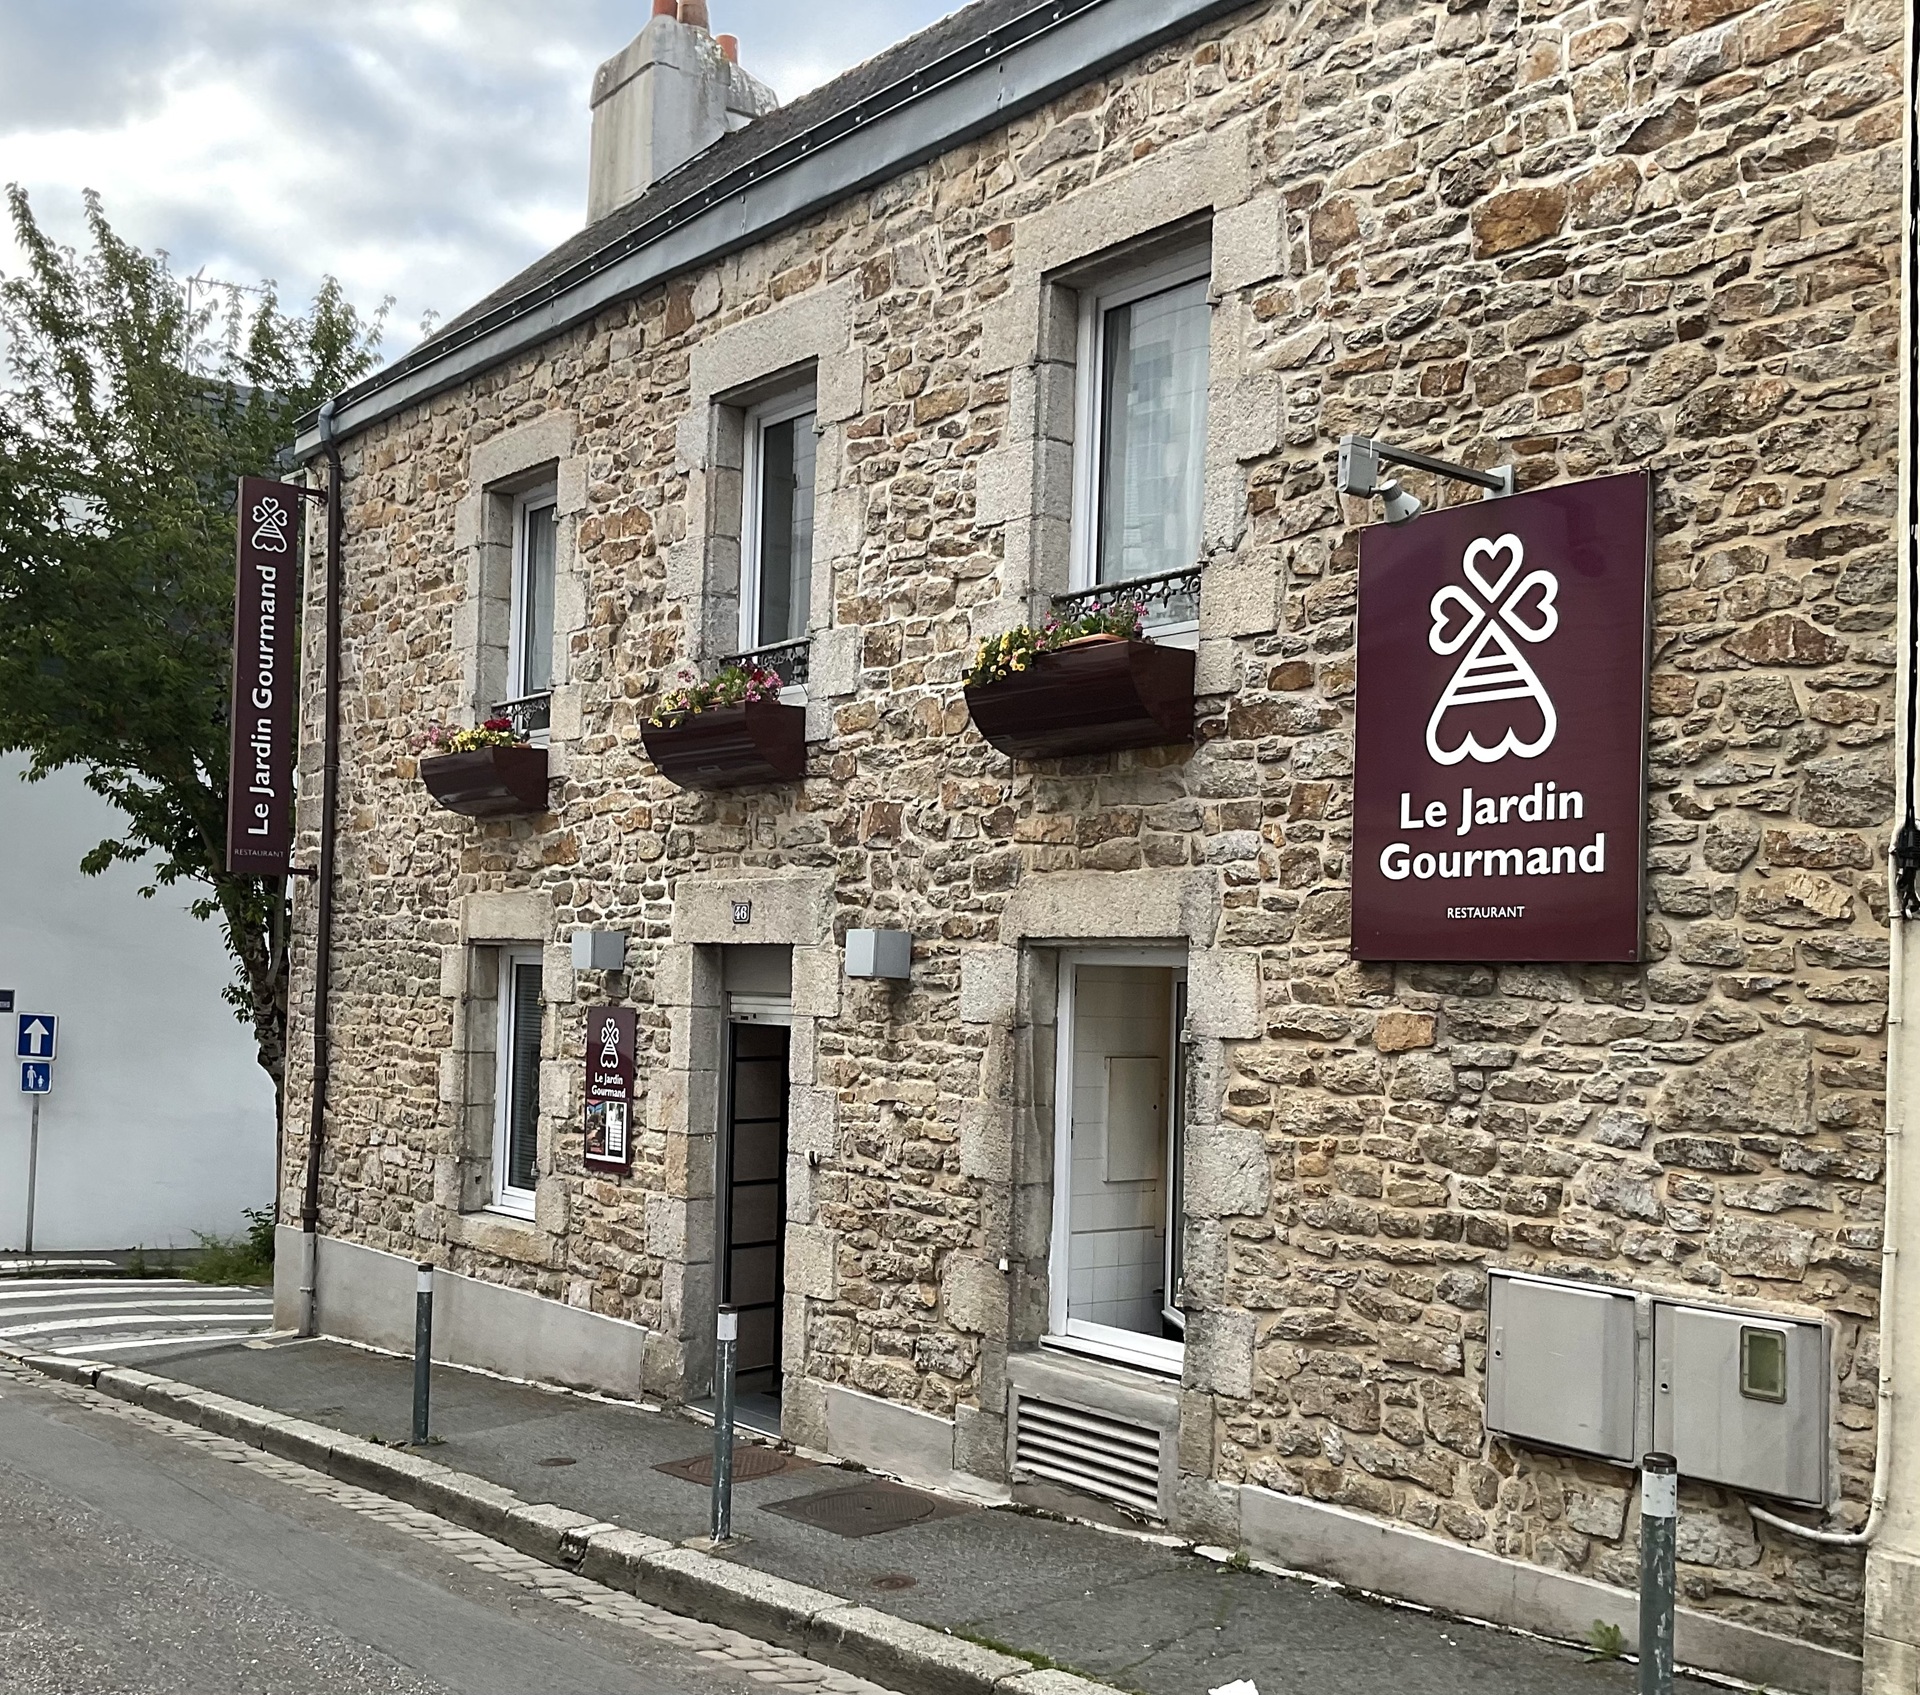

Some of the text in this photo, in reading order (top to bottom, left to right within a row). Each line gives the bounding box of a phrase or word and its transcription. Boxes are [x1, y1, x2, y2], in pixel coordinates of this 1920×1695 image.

[247, 564, 277, 835] Le Jardin Gourmand
[1400, 781, 1583, 836] Le Jardin
[234, 848, 284, 858] RESTAURANT
[1379, 832, 1605, 880] Gourmand
[734, 905, 748, 920] 46
[1446, 905, 1526, 919] RESTAURANT
[594, 1072, 623, 1085] Le Jardin
[591, 1085, 626, 1098] Gourmand
